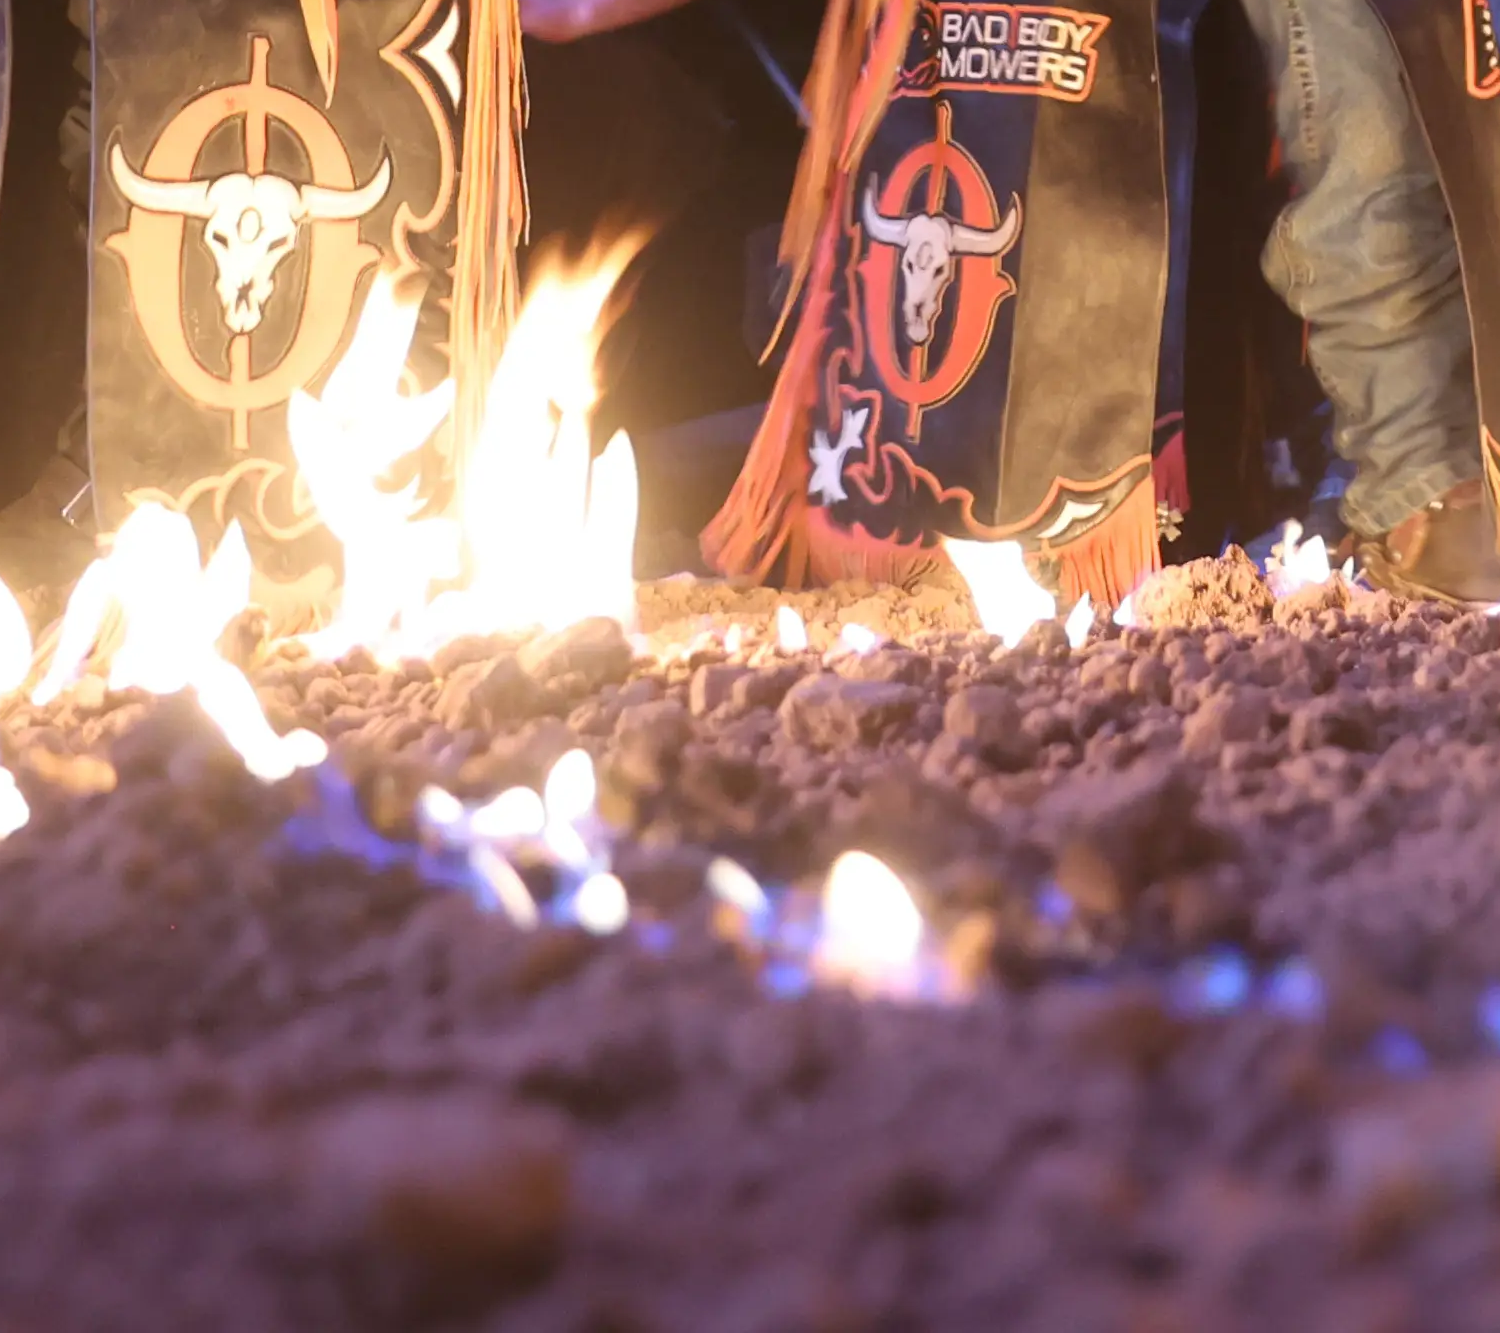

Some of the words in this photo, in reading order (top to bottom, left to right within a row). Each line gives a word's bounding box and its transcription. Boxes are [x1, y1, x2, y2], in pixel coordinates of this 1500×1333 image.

[941, 13, 1010, 45] BAD
[1017, 17, 1093, 53] BOY
[940, 46, 1088, 92] MOWERS
